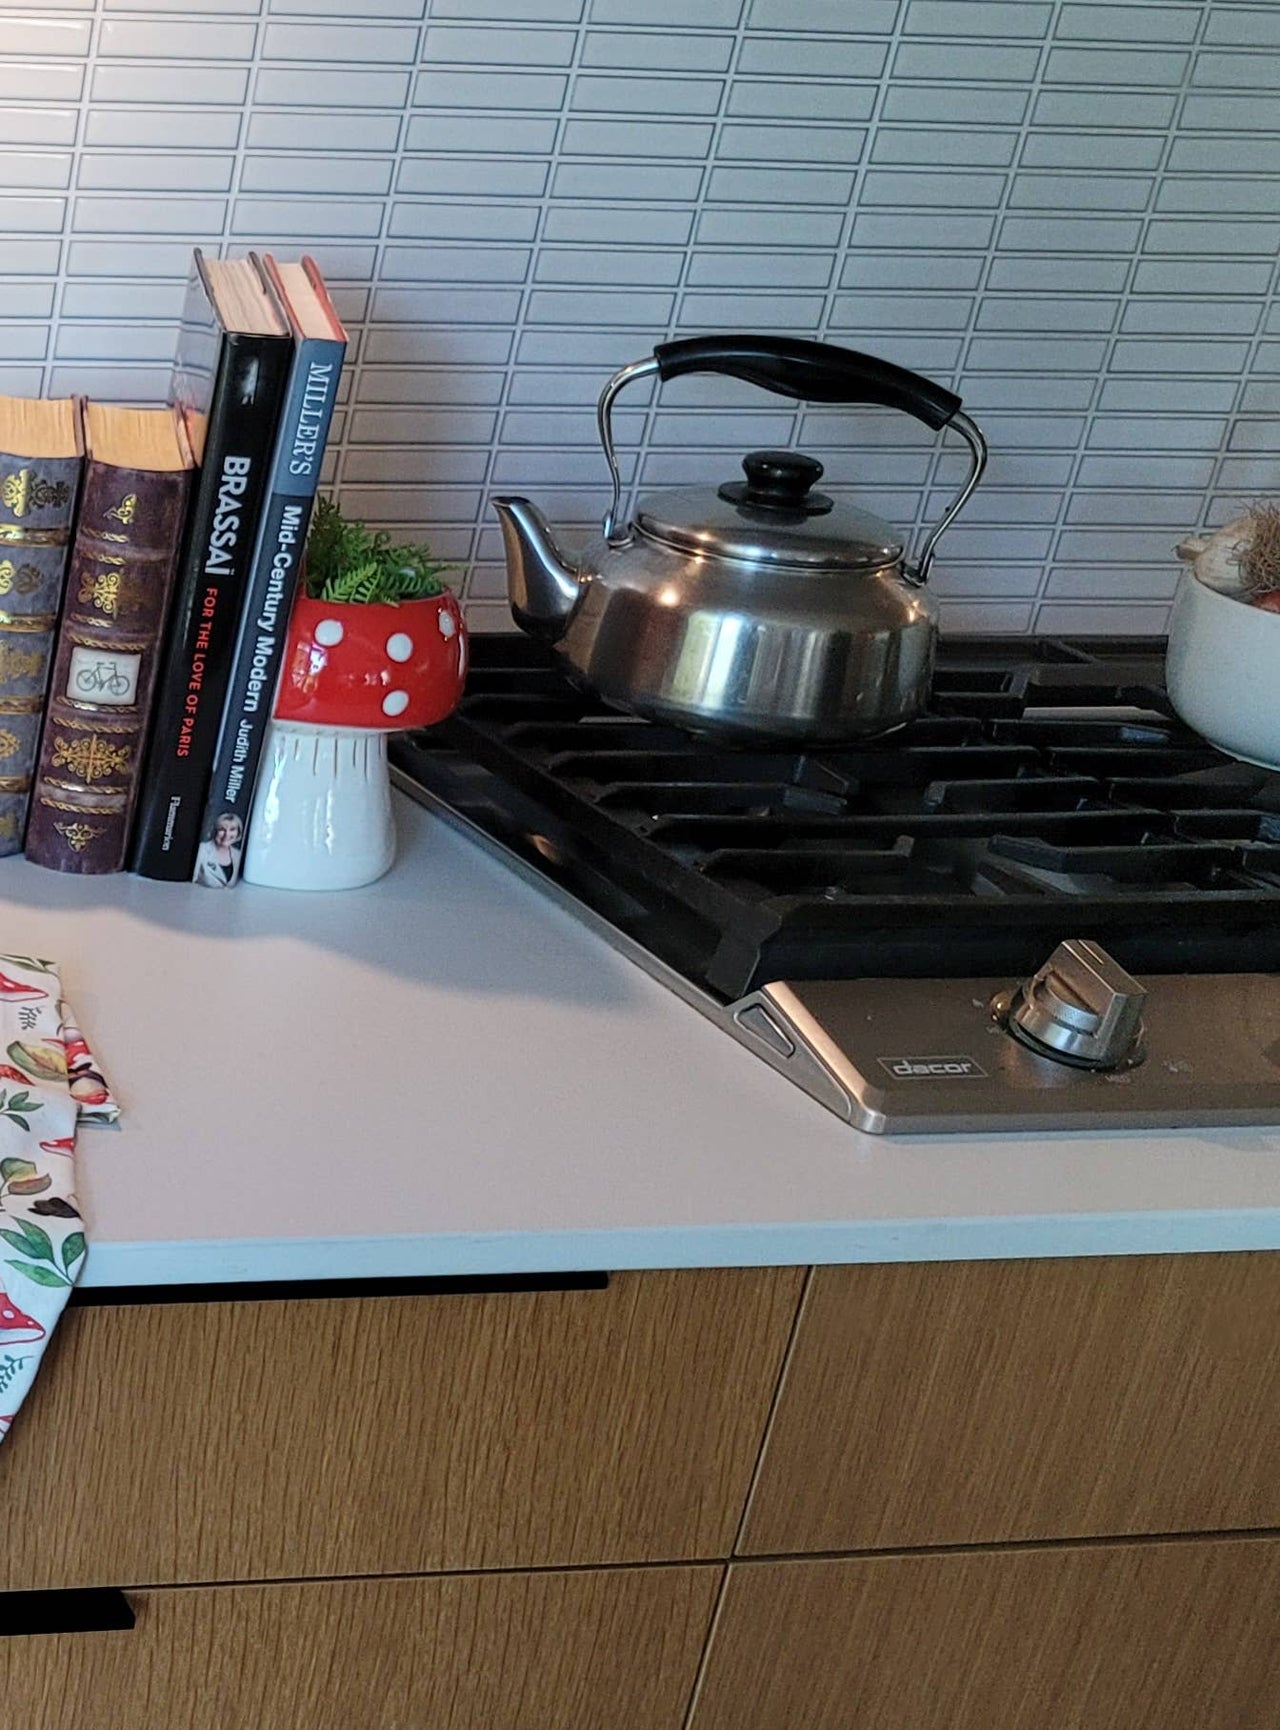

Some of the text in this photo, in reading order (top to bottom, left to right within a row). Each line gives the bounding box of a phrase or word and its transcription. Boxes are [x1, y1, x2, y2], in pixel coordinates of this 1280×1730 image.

[289, 361, 333, 476] MILLER'S
[204, 455, 251, 576] BRASSAÏ
[242, 505, 303, 713] Mid-Century Modern
[176, 586, 219, 758] FOR THE LOVE OF PARIS
[224, 718, 255, 804] Judith Miller
[893, 1060, 973, 1076] dacor
